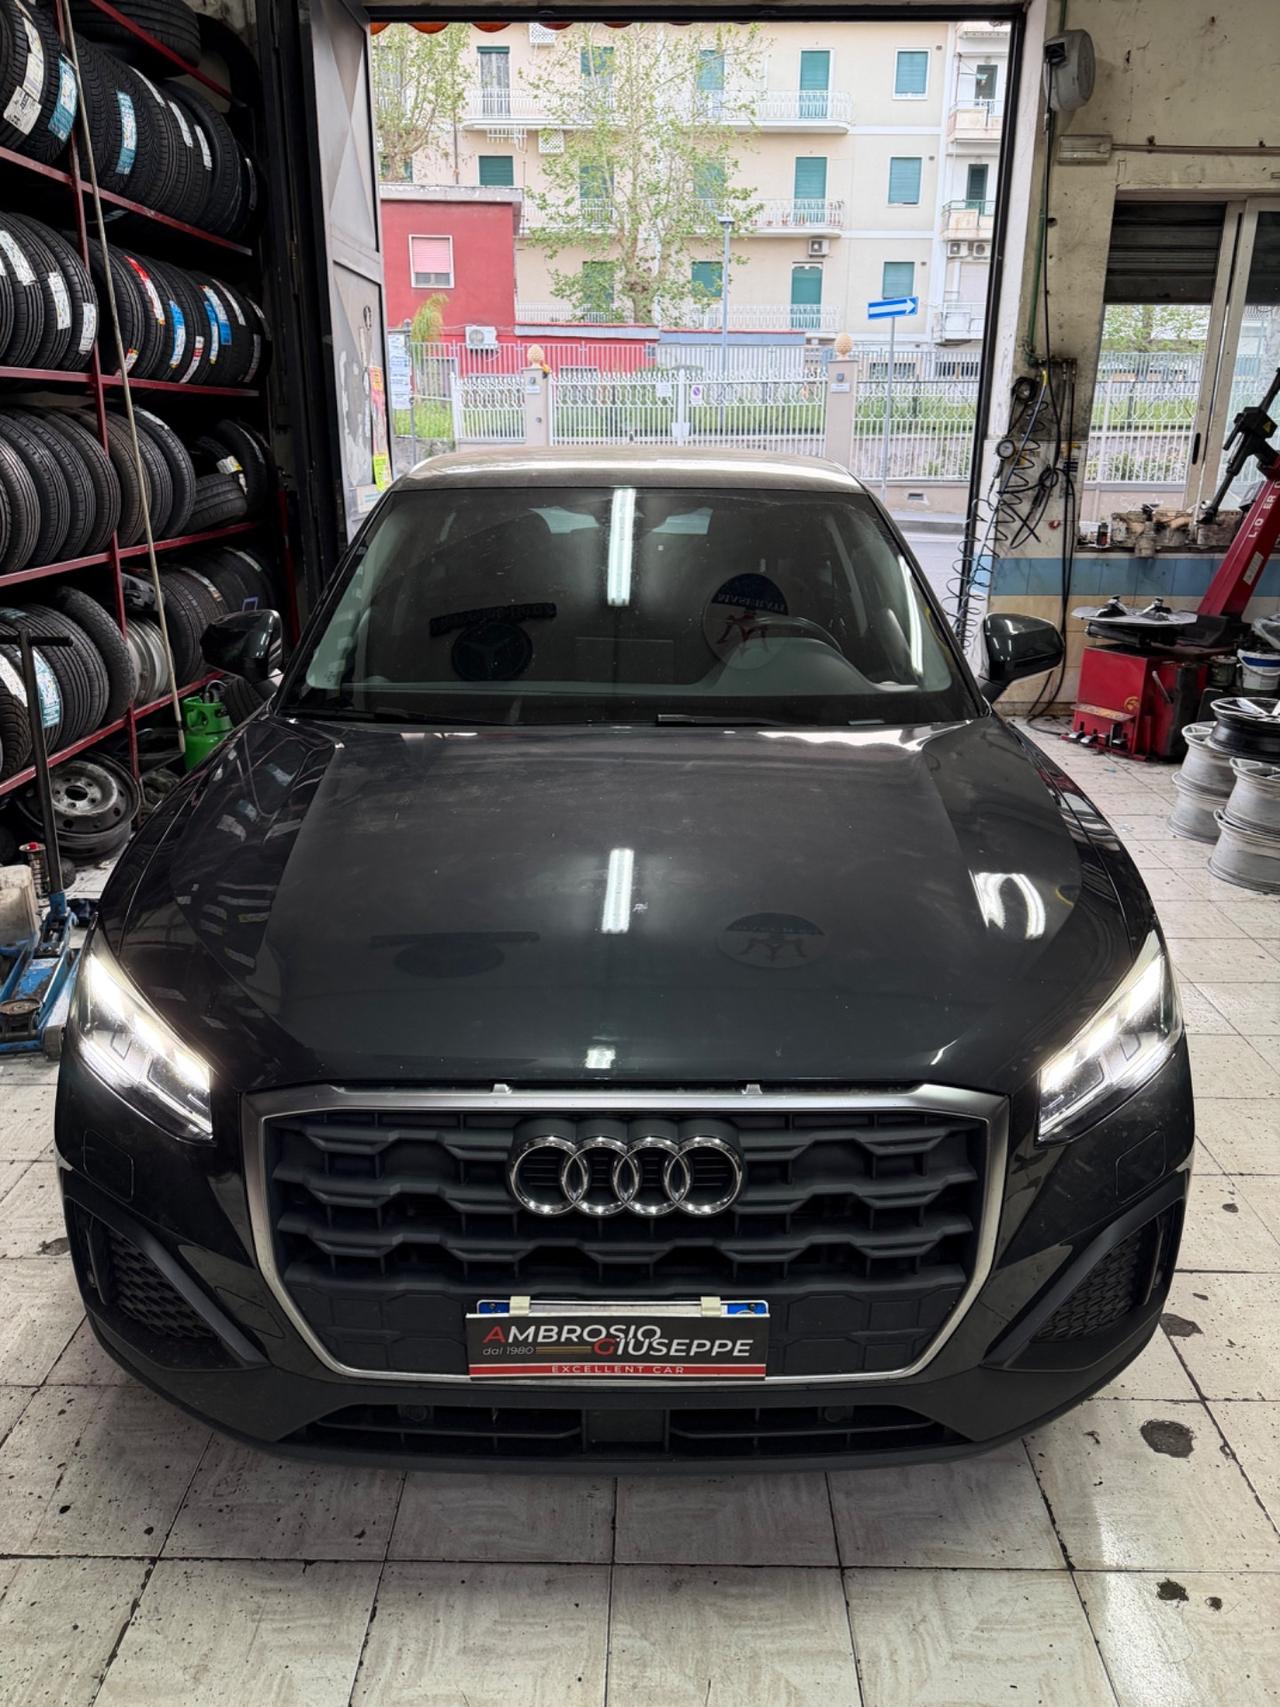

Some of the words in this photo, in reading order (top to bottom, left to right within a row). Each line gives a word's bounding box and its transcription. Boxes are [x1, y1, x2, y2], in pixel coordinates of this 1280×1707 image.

[483, 1324, 661, 1344] AMBROSIO
[482, 1347, 503, 1356] dal
[507, 1346, 534, 1355] 1980
[594, 1338, 754, 1357] GIUSEPPE
[551, 1365, 645, 1374] EXCELLENT
[652, 1365, 685, 1374] CAR
